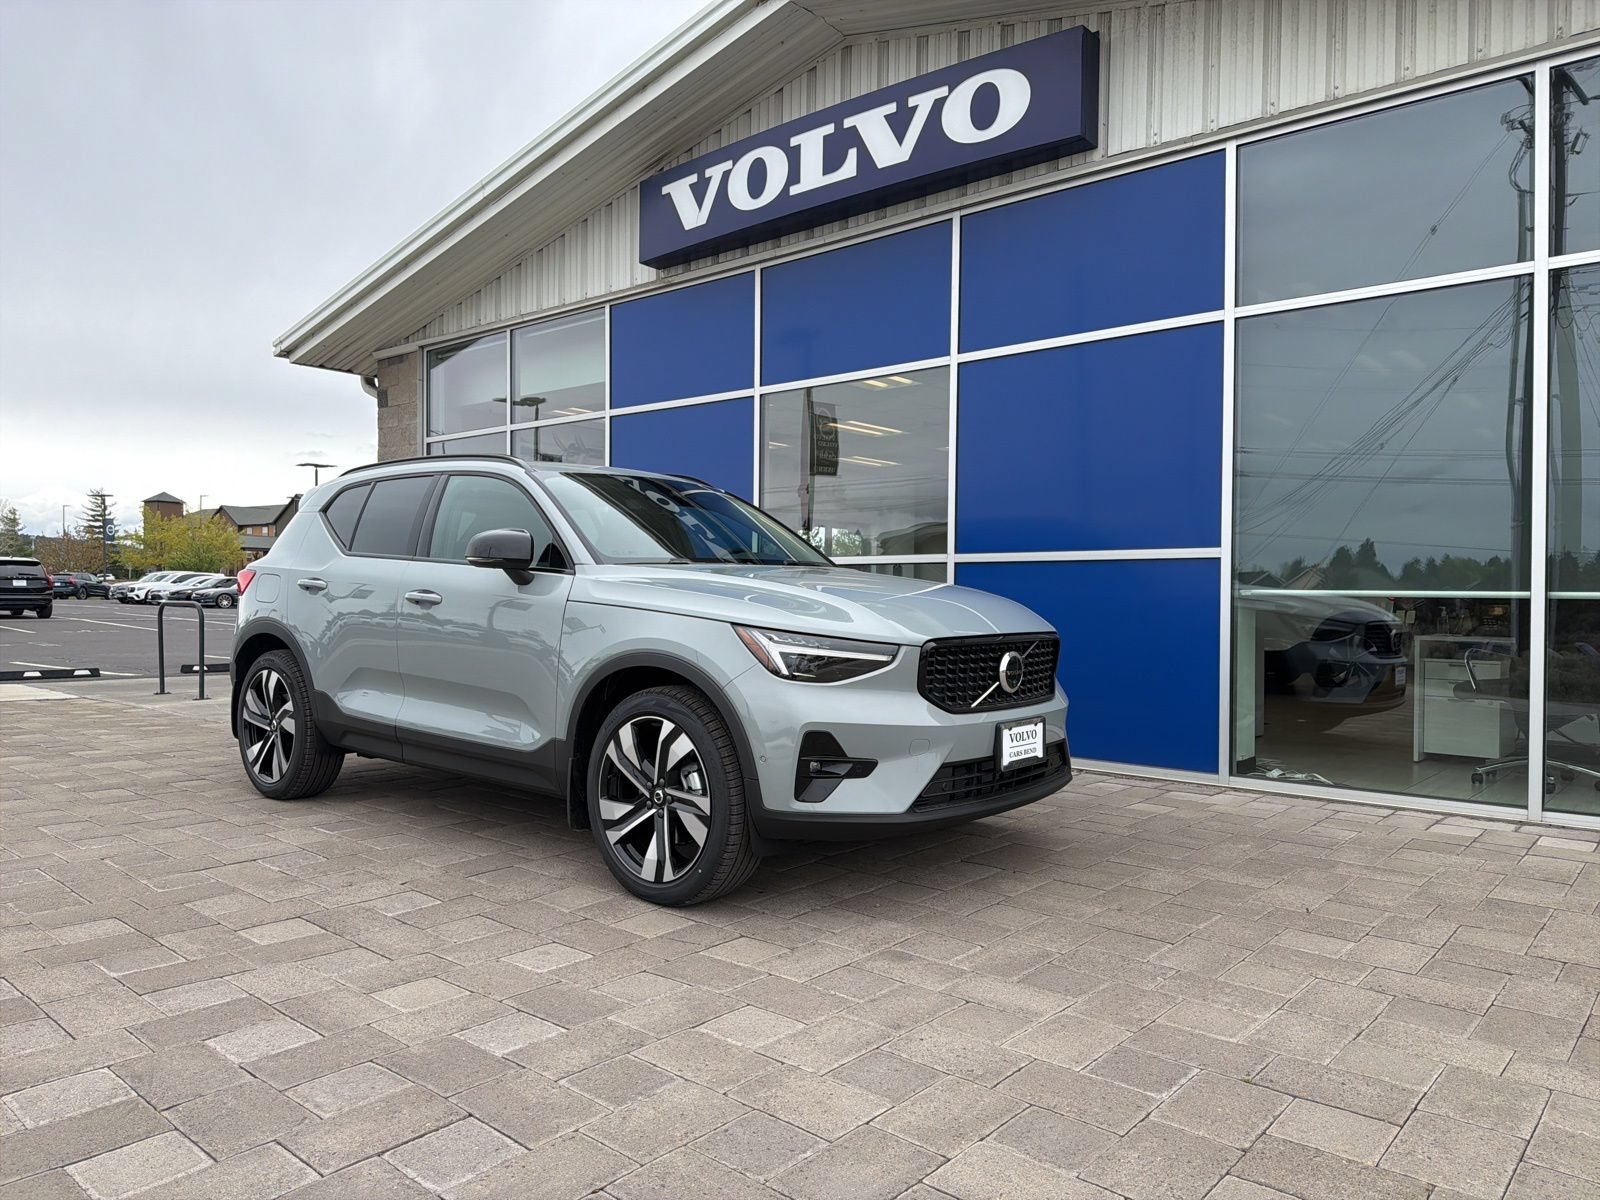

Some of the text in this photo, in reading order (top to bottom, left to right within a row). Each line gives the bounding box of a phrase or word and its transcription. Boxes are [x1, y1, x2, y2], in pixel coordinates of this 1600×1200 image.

[661, 68, 1032, 231] VOLVO
[1009, 729, 1037, 742] VOLVO
[1009, 747, 1037, 758] CARS BEND
